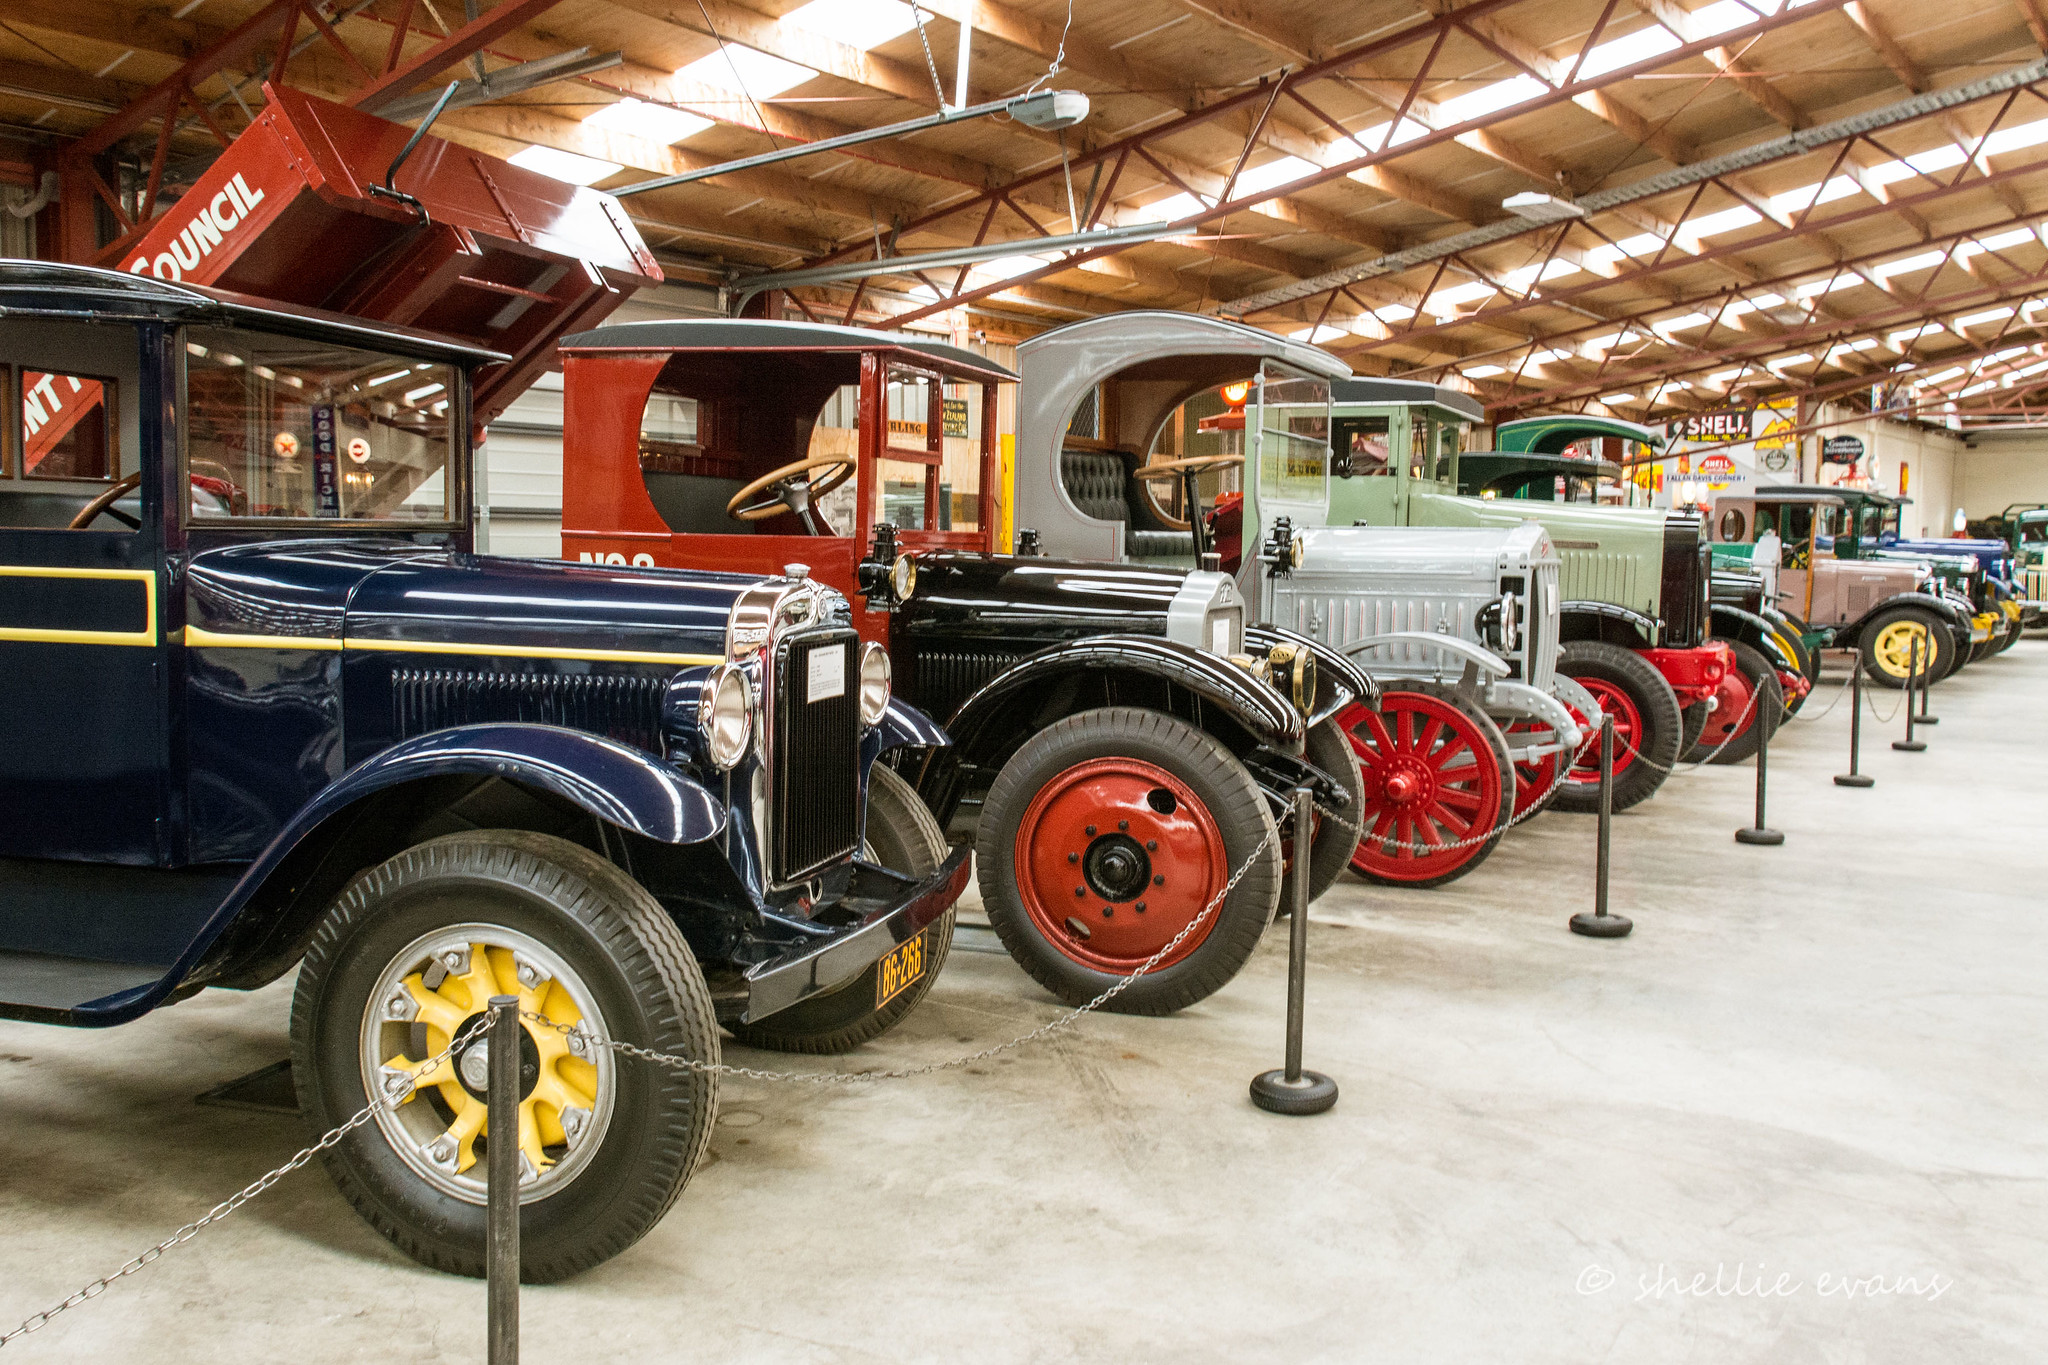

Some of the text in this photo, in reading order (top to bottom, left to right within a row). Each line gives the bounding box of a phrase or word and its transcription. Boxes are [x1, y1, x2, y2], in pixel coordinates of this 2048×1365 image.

[888, 421, 922, 434] RLING
[1687, 414, 1749, 435] SHELL
[1705, 459, 1729, 468] SHELL
